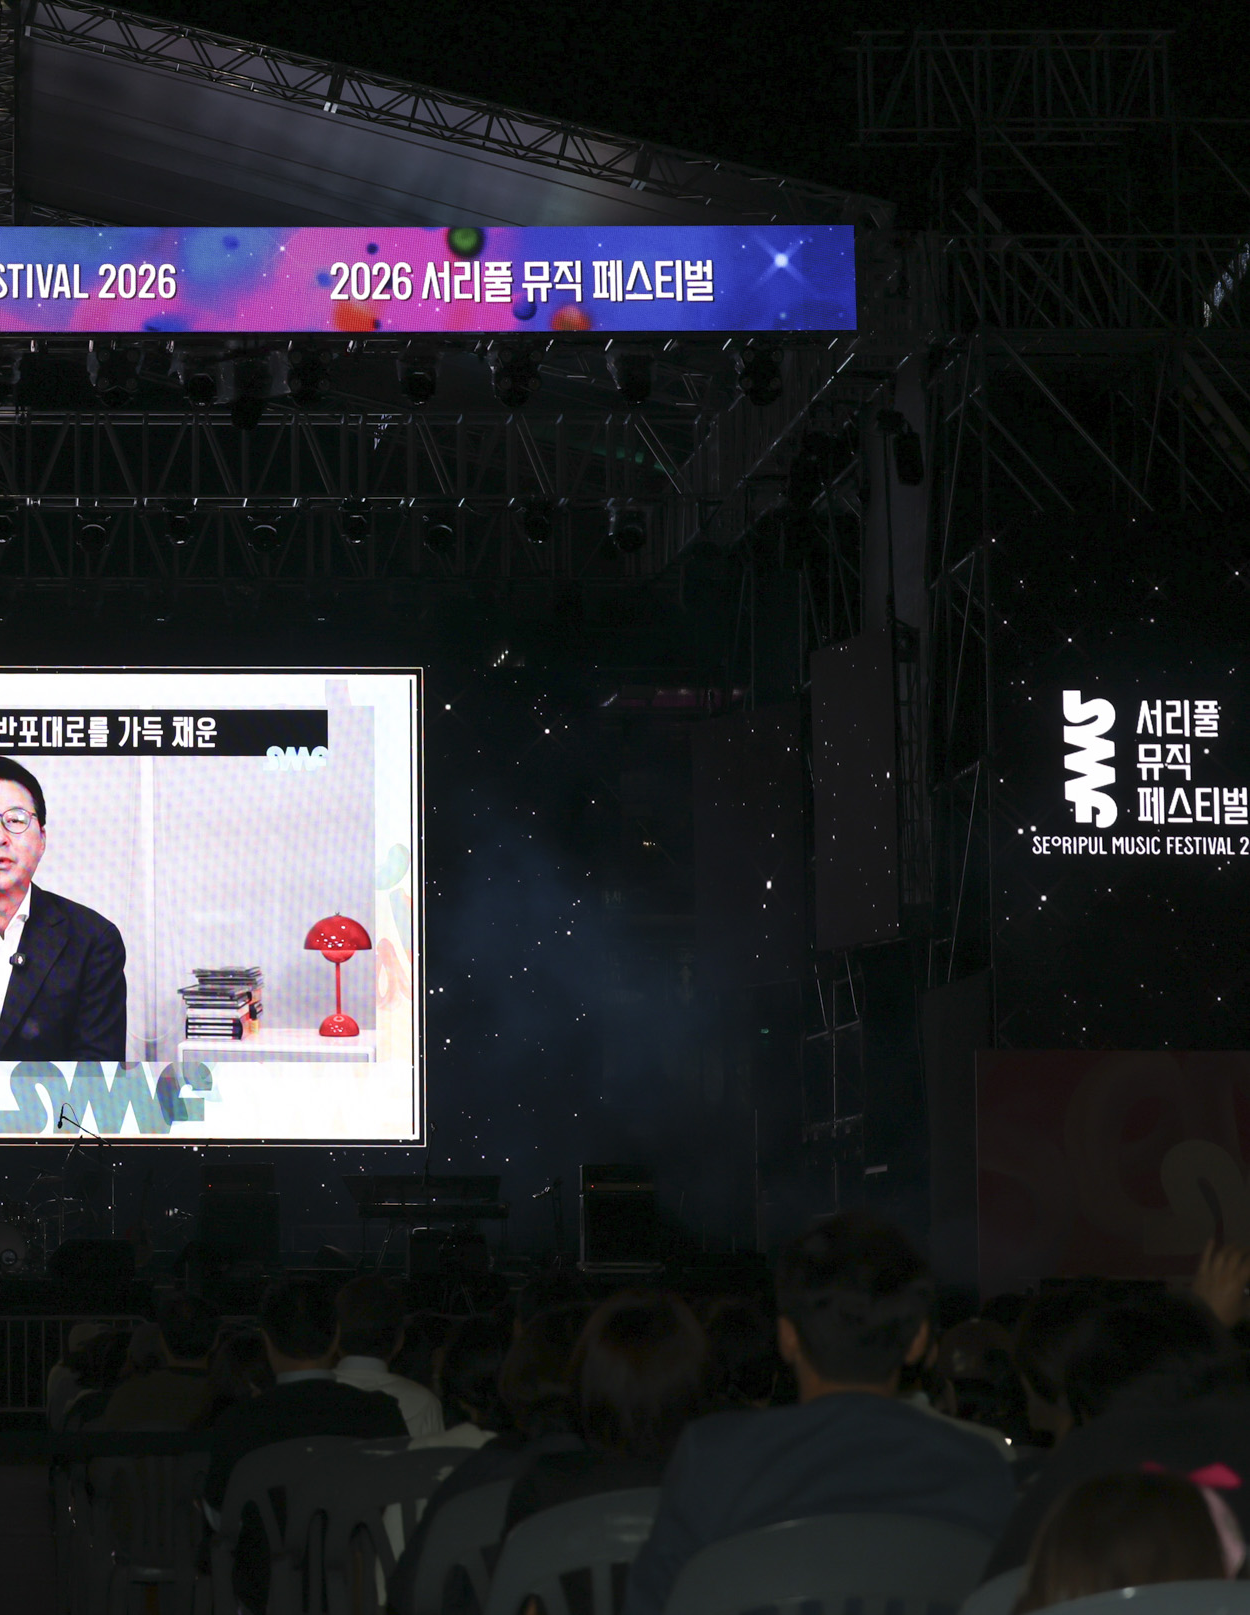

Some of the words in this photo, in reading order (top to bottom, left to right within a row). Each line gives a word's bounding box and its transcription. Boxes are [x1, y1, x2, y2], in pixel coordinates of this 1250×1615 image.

[98, 263, 176, 299] 2026
[330, 261, 412, 300] 2026
[421, 260, 513, 303] 서리풀
[521, 260, 582, 303] 뮤직
[592, 260, 714, 302] 페스티벌
[118, 716, 164, 748] 가득
[171, 716, 218, 748] 채운
[1136, 699, 1220, 737] 서리풀
[1136, 743, 1192, 781] 뮤직
[1137, 786, 1249, 825] 페스티벌
[1032, 835, 1108, 855] SEORIPUL
[1112, 836, 1161, 855] MUSIC
[1166, 836, 1236, 855] FESTIVAL
